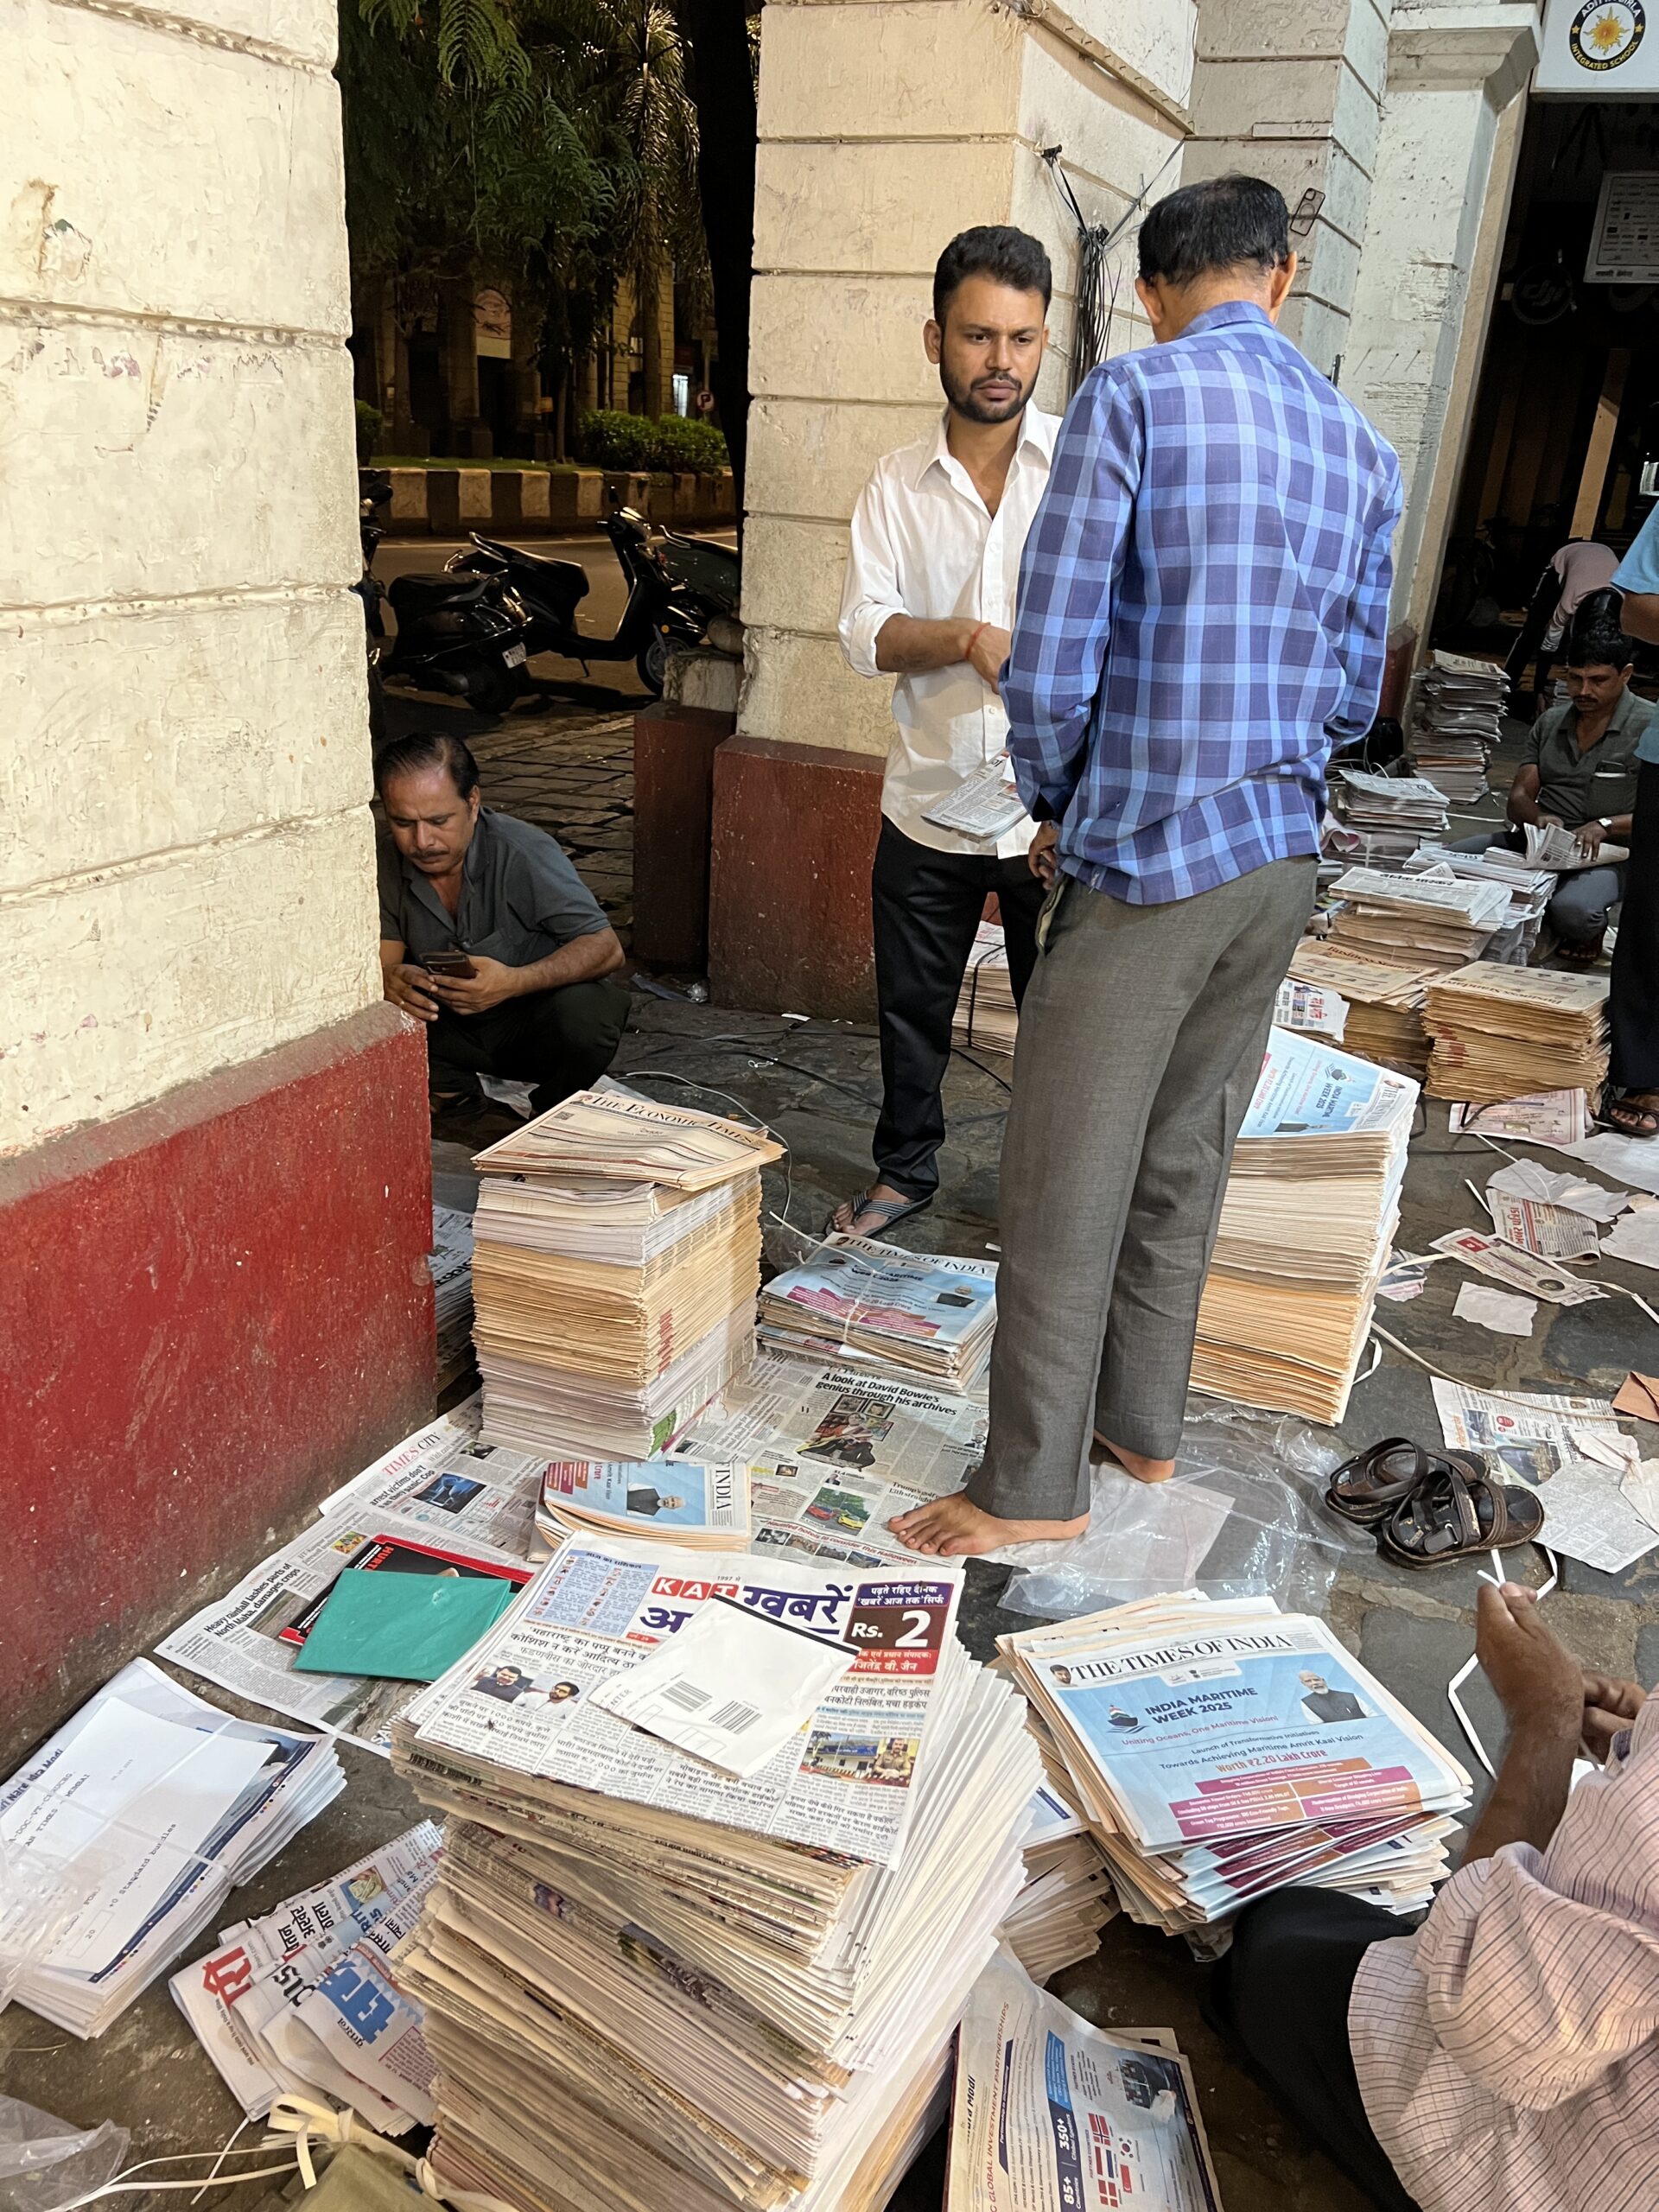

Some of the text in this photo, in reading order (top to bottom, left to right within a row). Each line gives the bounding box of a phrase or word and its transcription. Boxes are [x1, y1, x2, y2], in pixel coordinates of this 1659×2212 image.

[1572, 41, 1639, 69] INTEGRATED SCHOOL
[1320, 1082, 1333, 1099] WEEK
[849, 1236, 876, 1255] THE
[923, 1255, 941, 1264] OF
[944, 1262, 986, 1274] INDIA
[816, 1381, 957, 1416] genius through his archives
[830, 1373, 849, 1385] look
[852, 1378, 867, 1388] at
[868, 1380, 897, 1395] David
[899, 1386, 940, 1402] Bowie's
[381, 1446, 420, 1477] TIMES
[416, 1431, 441, 1451] CITY
[370, 1464, 426, 1506] arrest victims don't
[715, 1470, 733, 1510] INDIA
[767, 1521, 798, 1531] Haunted
[798, 1527, 820, 1538] hotels
[830, 1536, 861, 1548] consider
[877, 1548, 918, 1565] Halloween
[204, 1615, 229, 1633] Heavy
[224, 1599, 250, 1620] rainfall
[246, 1580, 270, 1601] lashes
[266, 1567, 285, 1584] parts
[214, 1567, 301, 1637] North Maha, damages crops
[743, 1583, 854, 1624] खबरें
[511, 1632, 550, 1648] कोशिश
[551, 1642, 558, 1650] न
[851, 1610, 931, 1648] Rs. 2
[901, 1662, 917, 1671] जैन
[1071, 1633, 1292, 1679] THE TIMES OF INDIA
[910, 1689, 931, 1699] पुलिस
[1145, 1688, 1258, 1715] INDIA MARITIME
[1152, 1701, 1232, 1724] WEEK 2025
[1122, 1736, 1155, 1746] Uniting
[1155, 1731, 1191, 1743] Oceans,
[1211, 1719, 1249, 1731] Maritime
[1191, 1743, 1220, 1755] Launch
[1230, 1732, 1284, 1747] Transformative
[1285, 1729, 1320, 1740] Initiatives
[1159, 1733, 1364, 1770] Towards Achieving Maritime Amrit Kaal Vision
[1216, 1760, 1247, 1772] Worth
[1249, 1756, 1276, 1767] ₹2.20
[1277, 1753, 1300, 1764] Lakh
[1301, 1749, 1328, 1759] Crore
[7, 1768, 45, 1802] Naredra
[118, 1857, 151, 1896] Standard
[149, 1822, 178, 1857] budles
[966, 2075, 976, 2106] Modi
[987, 2001, 1009, 2202] GLOBAL INVESTMENT PARTNERSHIPS
[1057, 2118, 1074, 2204] 350+ 85+
